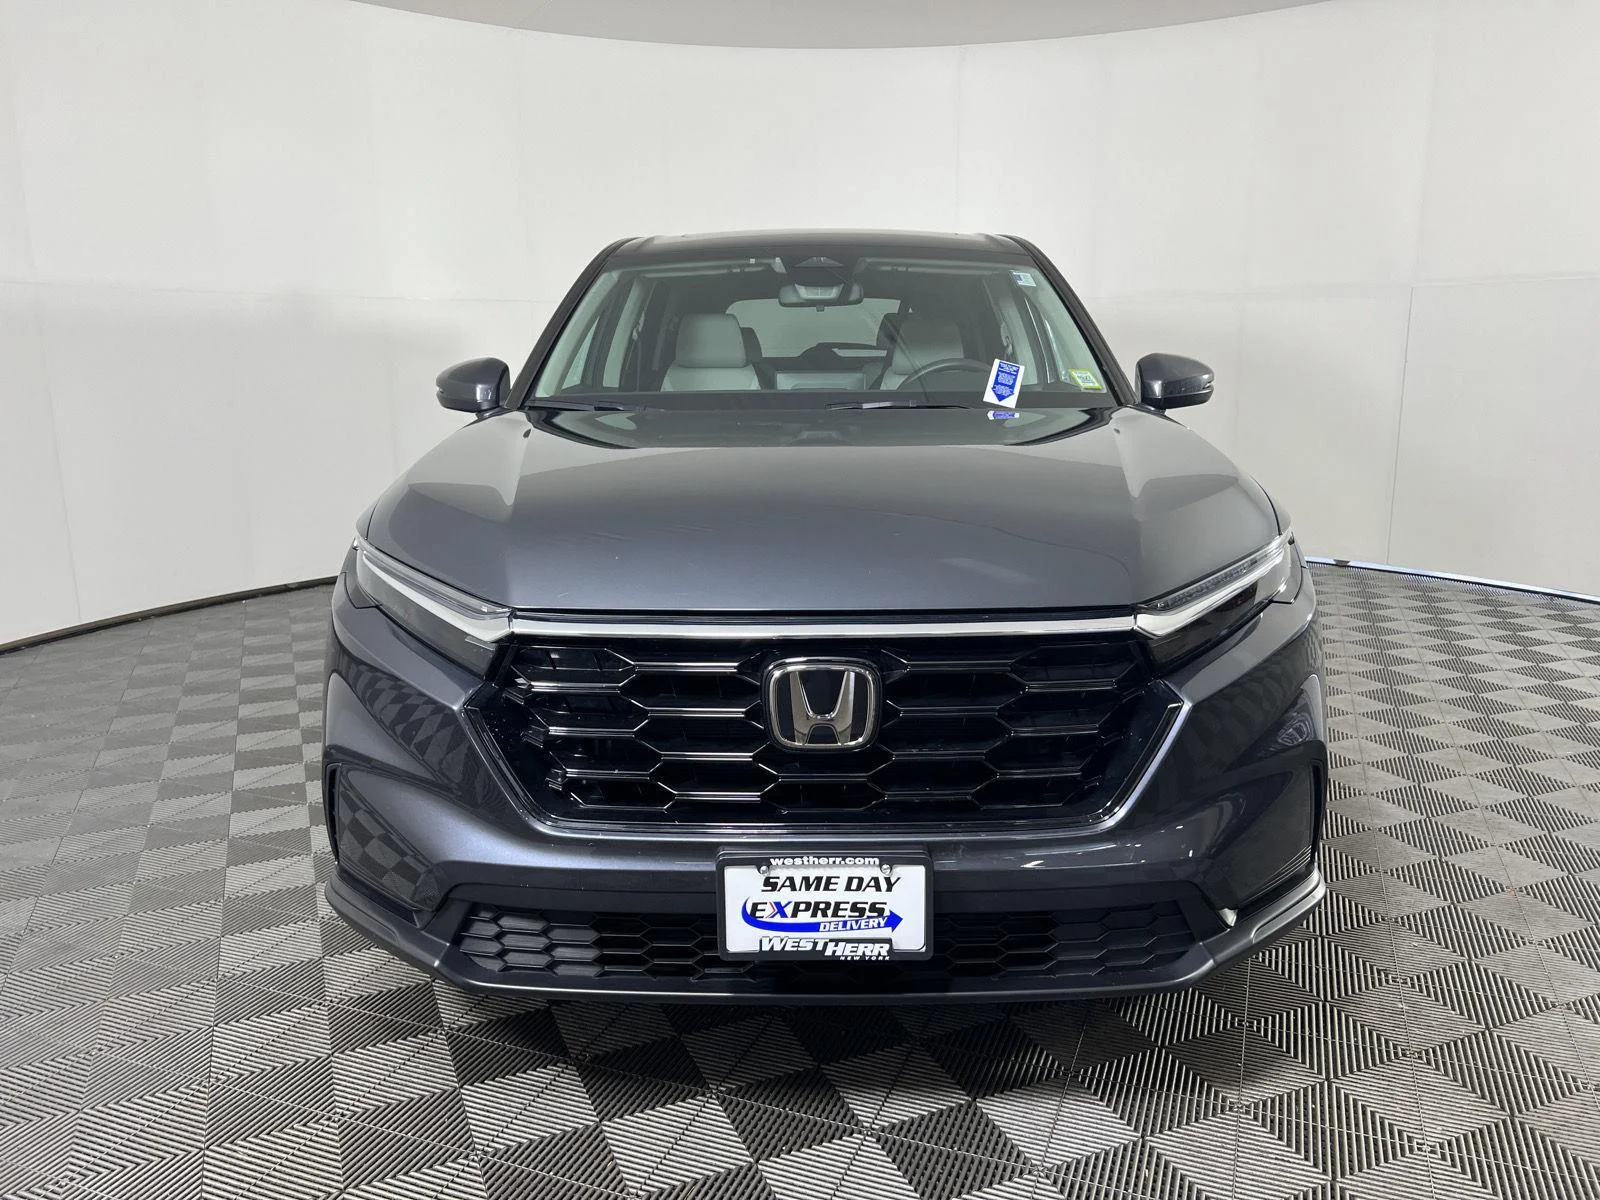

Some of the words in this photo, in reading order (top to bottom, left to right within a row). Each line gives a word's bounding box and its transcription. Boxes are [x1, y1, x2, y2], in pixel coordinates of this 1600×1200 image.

[770, 856, 879, 865] westherr.com
[761, 876, 840, 892] SAME
[844, 876, 901, 892] DAY
[750, 901, 887, 918] EXPRESS
[819, 917, 888, 932] DELIVERY
